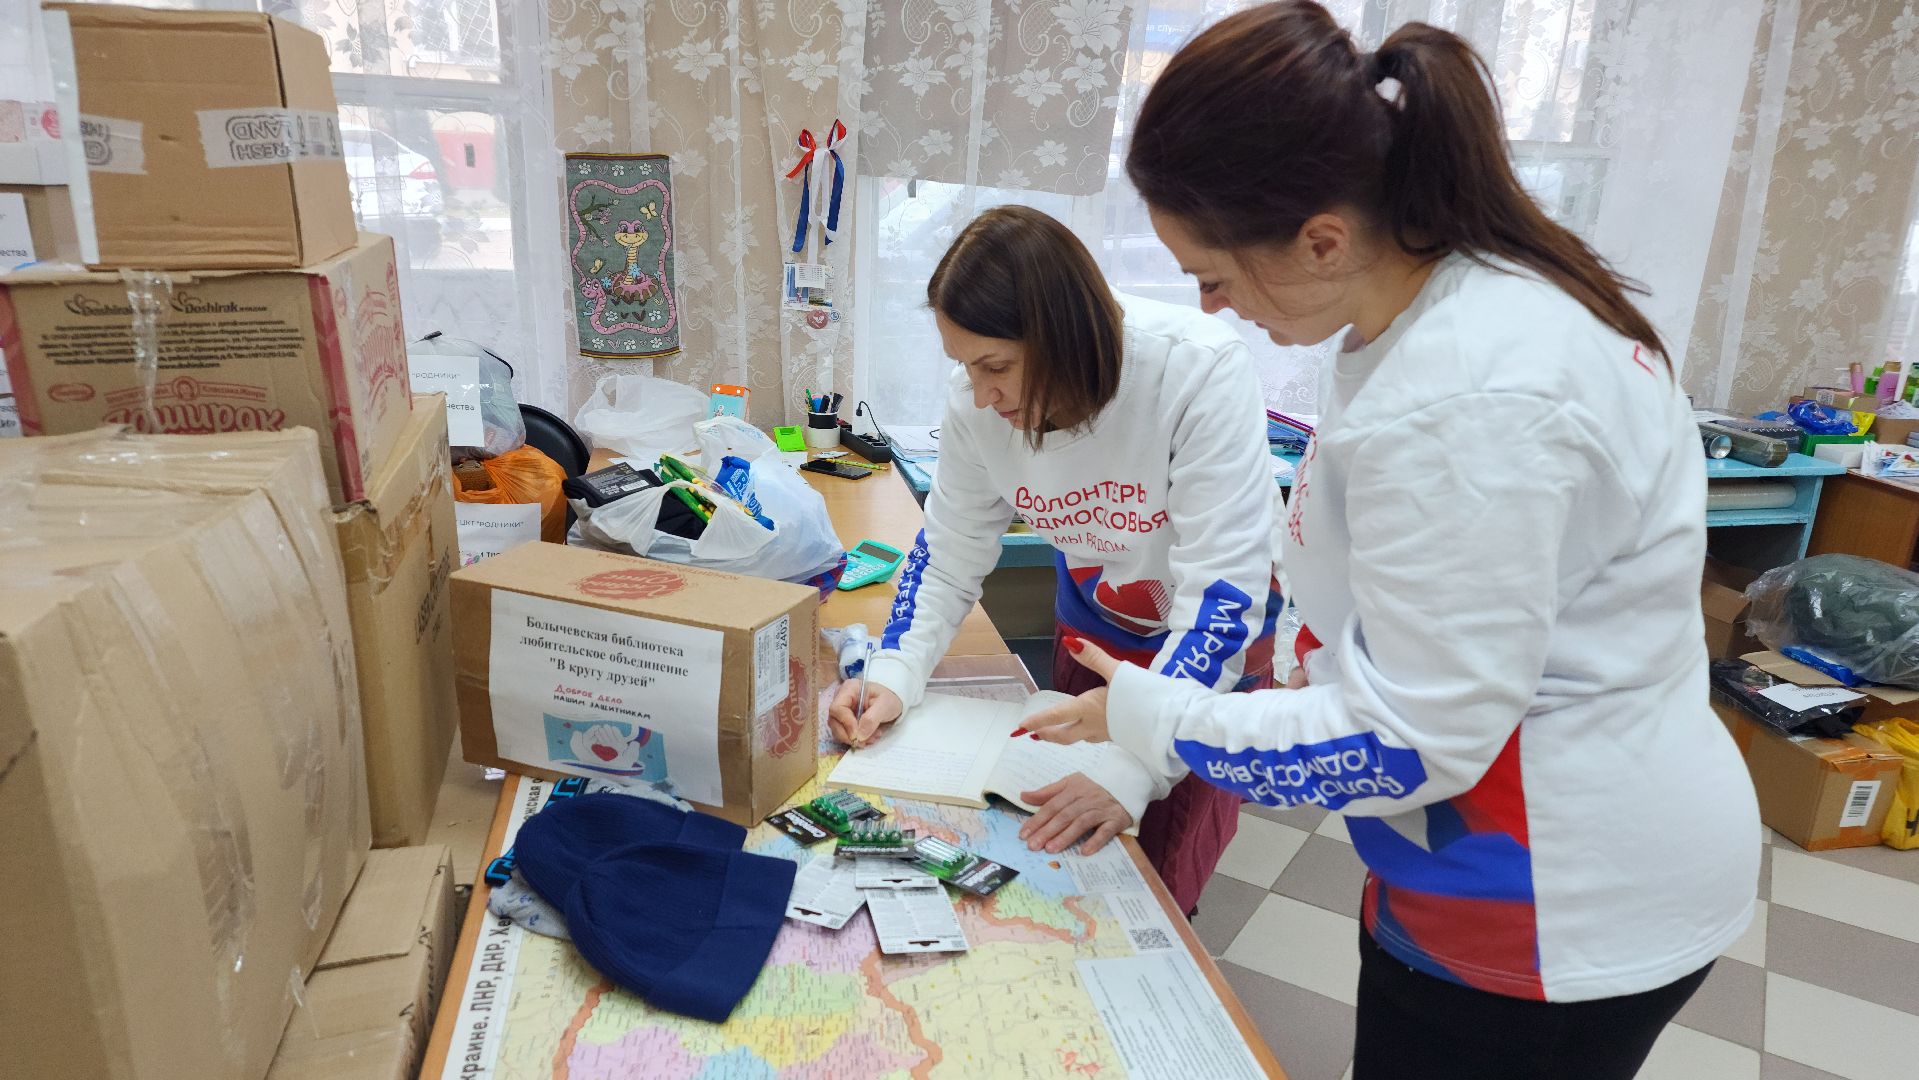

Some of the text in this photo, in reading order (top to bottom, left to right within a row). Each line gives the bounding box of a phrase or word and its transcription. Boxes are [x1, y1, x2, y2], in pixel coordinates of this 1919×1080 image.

[236, 143, 293, 159] RESH
[184, 301, 238, 314] Doshirak
[519, 635, 689, 677] любительское объединение
[526, 615, 684, 657] Болычевская библиотека
[1170, 631, 1225, 678] РЯД
[549, 657, 655, 688] "В кругу друзей"
[460, 1016, 491, 1080] краине.
